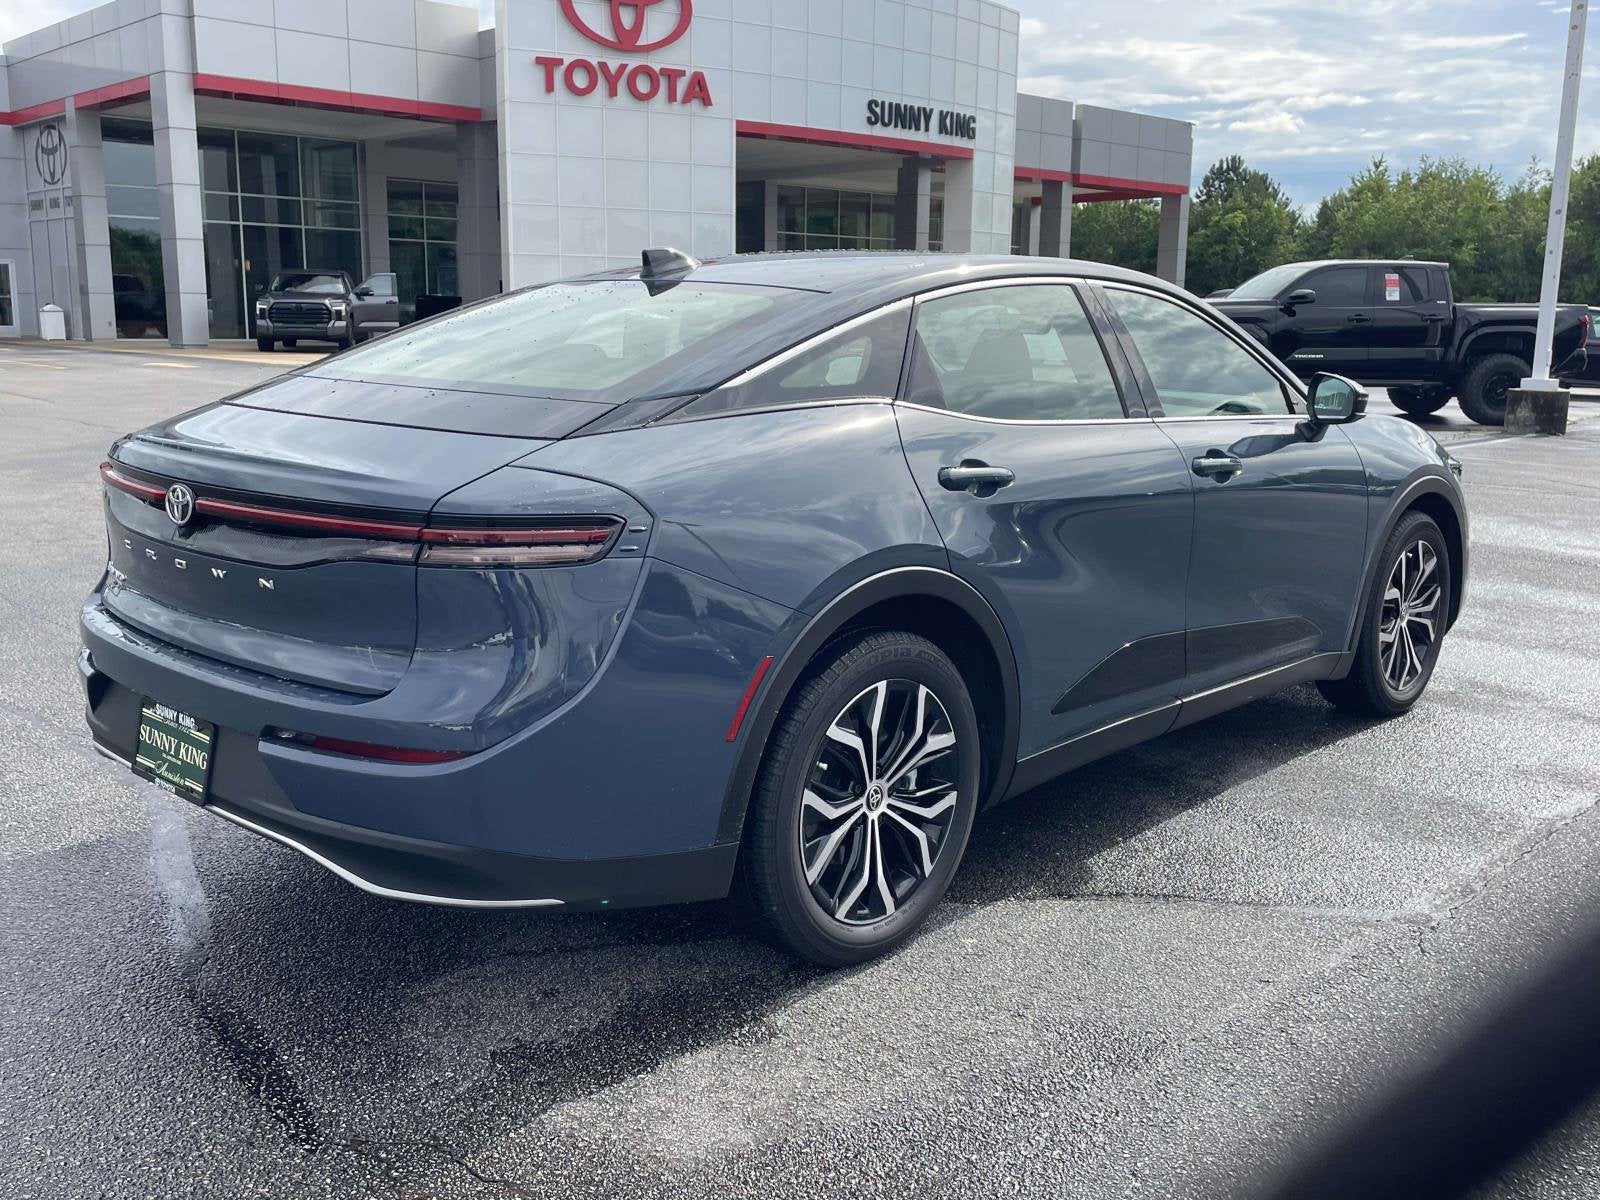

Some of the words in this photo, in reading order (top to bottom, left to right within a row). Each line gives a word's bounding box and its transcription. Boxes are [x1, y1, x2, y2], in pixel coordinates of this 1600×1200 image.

[535, 56, 713, 107] TOYOTA
[866, 98, 934, 132] SUNNY
[938, 109, 976, 140] KING
[123, 539, 275, 591] CROWN
[155, 703, 178, 722] SUNNY
[178, 712, 196, 730] KING
[139, 724, 178, 755] SUNNY
[179, 741, 208, 770] KING
